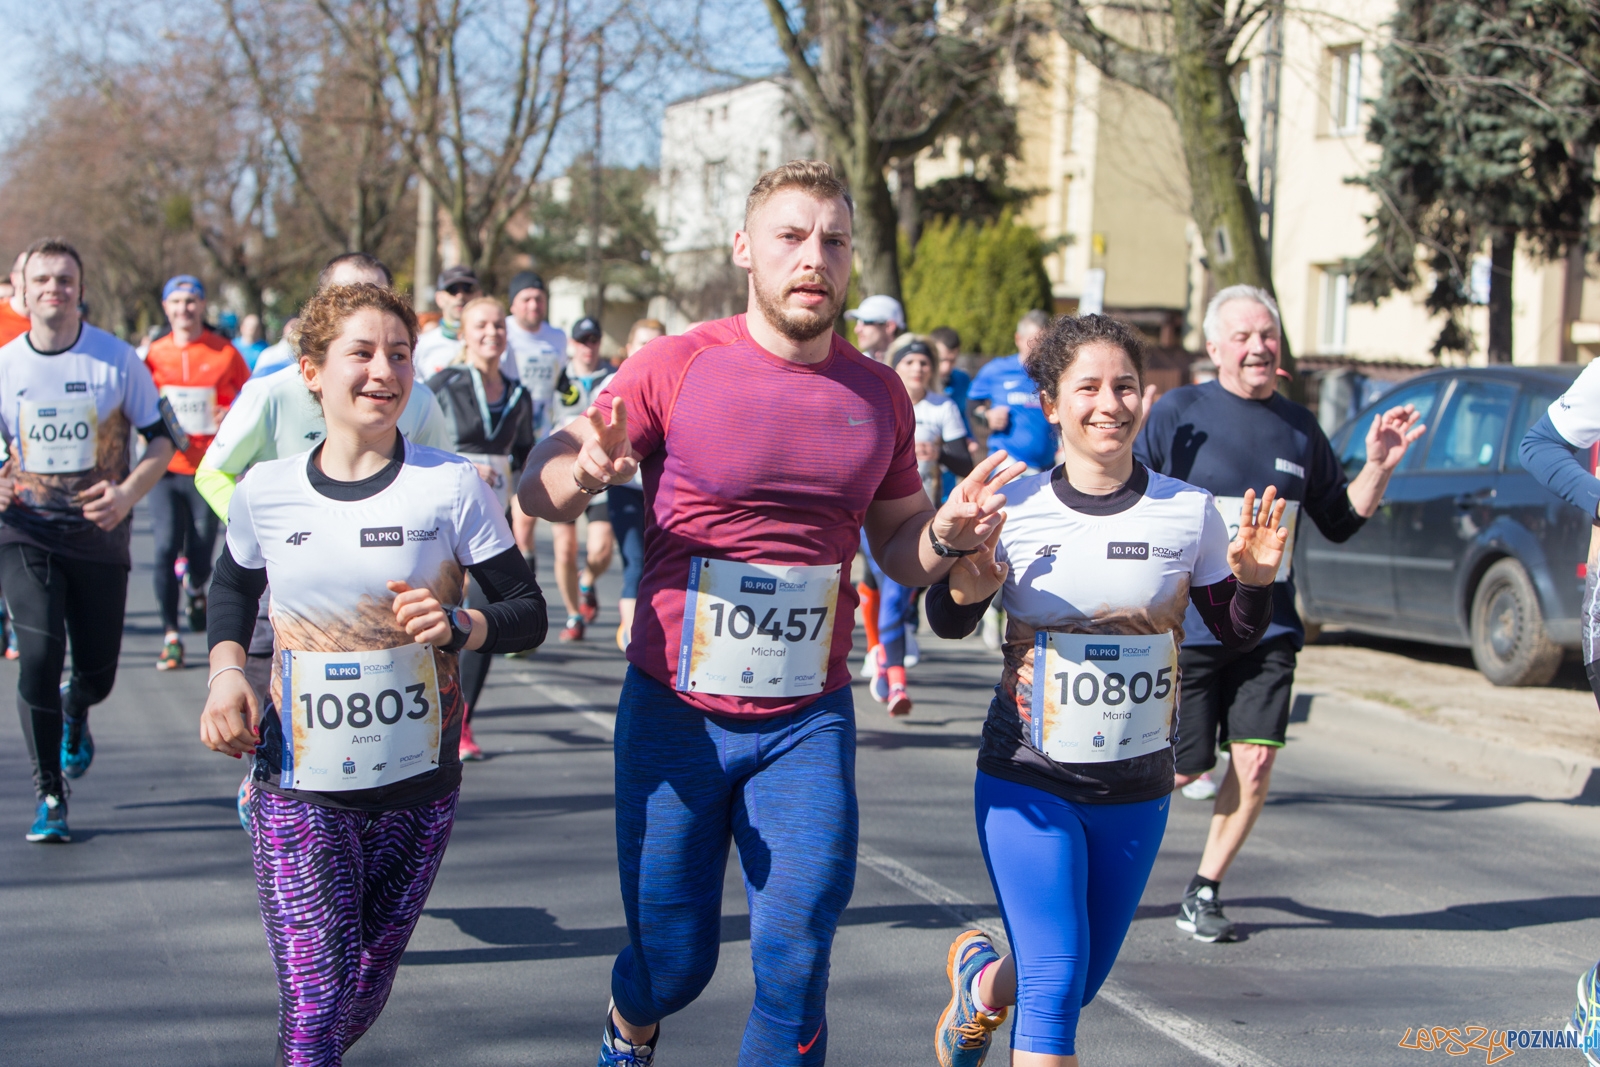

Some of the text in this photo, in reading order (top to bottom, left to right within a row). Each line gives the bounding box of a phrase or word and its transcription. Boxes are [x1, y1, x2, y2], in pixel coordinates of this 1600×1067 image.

[29, 421, 89, 442] 4040
[304, 431, 321, 441] 4F
[286, 532, 312, 545] 4F
[364, 532, 400, 542] 10. PKO
[1035, 544, 1061, 557] 4F
[1112, 546, 1145, 555] 10. PKO
[744, 581, 774, 590] 10. PKO
[709, 602, 828, 642] 10457
[752, 646, 786, 657] Michał
[1100, 649, 1117, 657] PKO
[328, 667, 358, 676] 10. PKO
[768, 677, 783, 685] 4F
[1054, 666, 1172, 706] 10805
[300, 682, 429, 730] 10803
[1103, 711, 1131, 720] Maria
[352, 733, 381, 744] Anna
[1119, 737, 1132, 746] 4F
[372, 762, 387, 771] 4F
